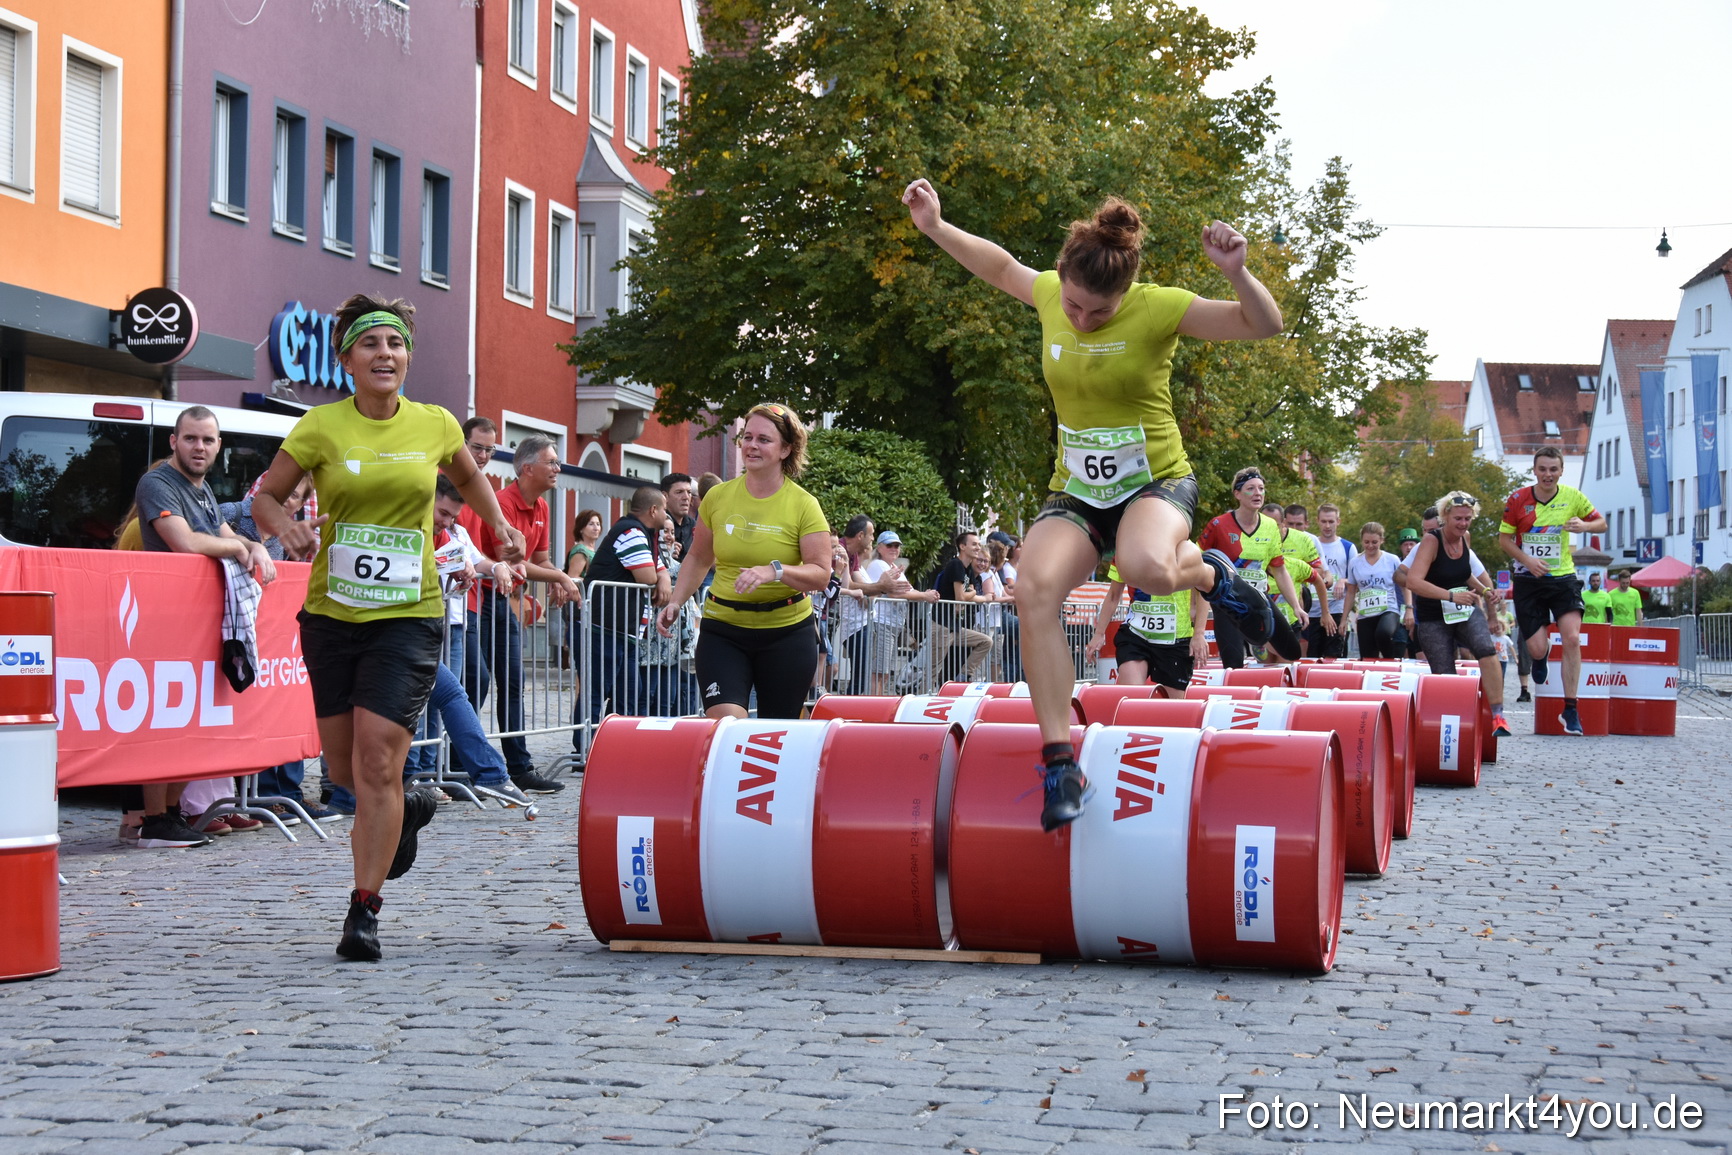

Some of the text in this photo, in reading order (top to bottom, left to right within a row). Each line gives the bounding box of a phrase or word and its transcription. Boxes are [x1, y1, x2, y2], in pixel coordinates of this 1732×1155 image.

[127, 334, 185, 346] hunkemöller
[1084, 454, 1117, 480] 66
[341, 527, 416, 552] BOCK
[1524, 533, 1561, 544] BOCK
[1529, 545, 1552, 557] 162
[354, 555, 390, 582] 62
[336, 582, 408, 601] CORNELIA
[1132, 602, 1172, 613] BOCK
[1364, 596, 1380, 607] 141
[1141, 616, 1165, 630] 163
